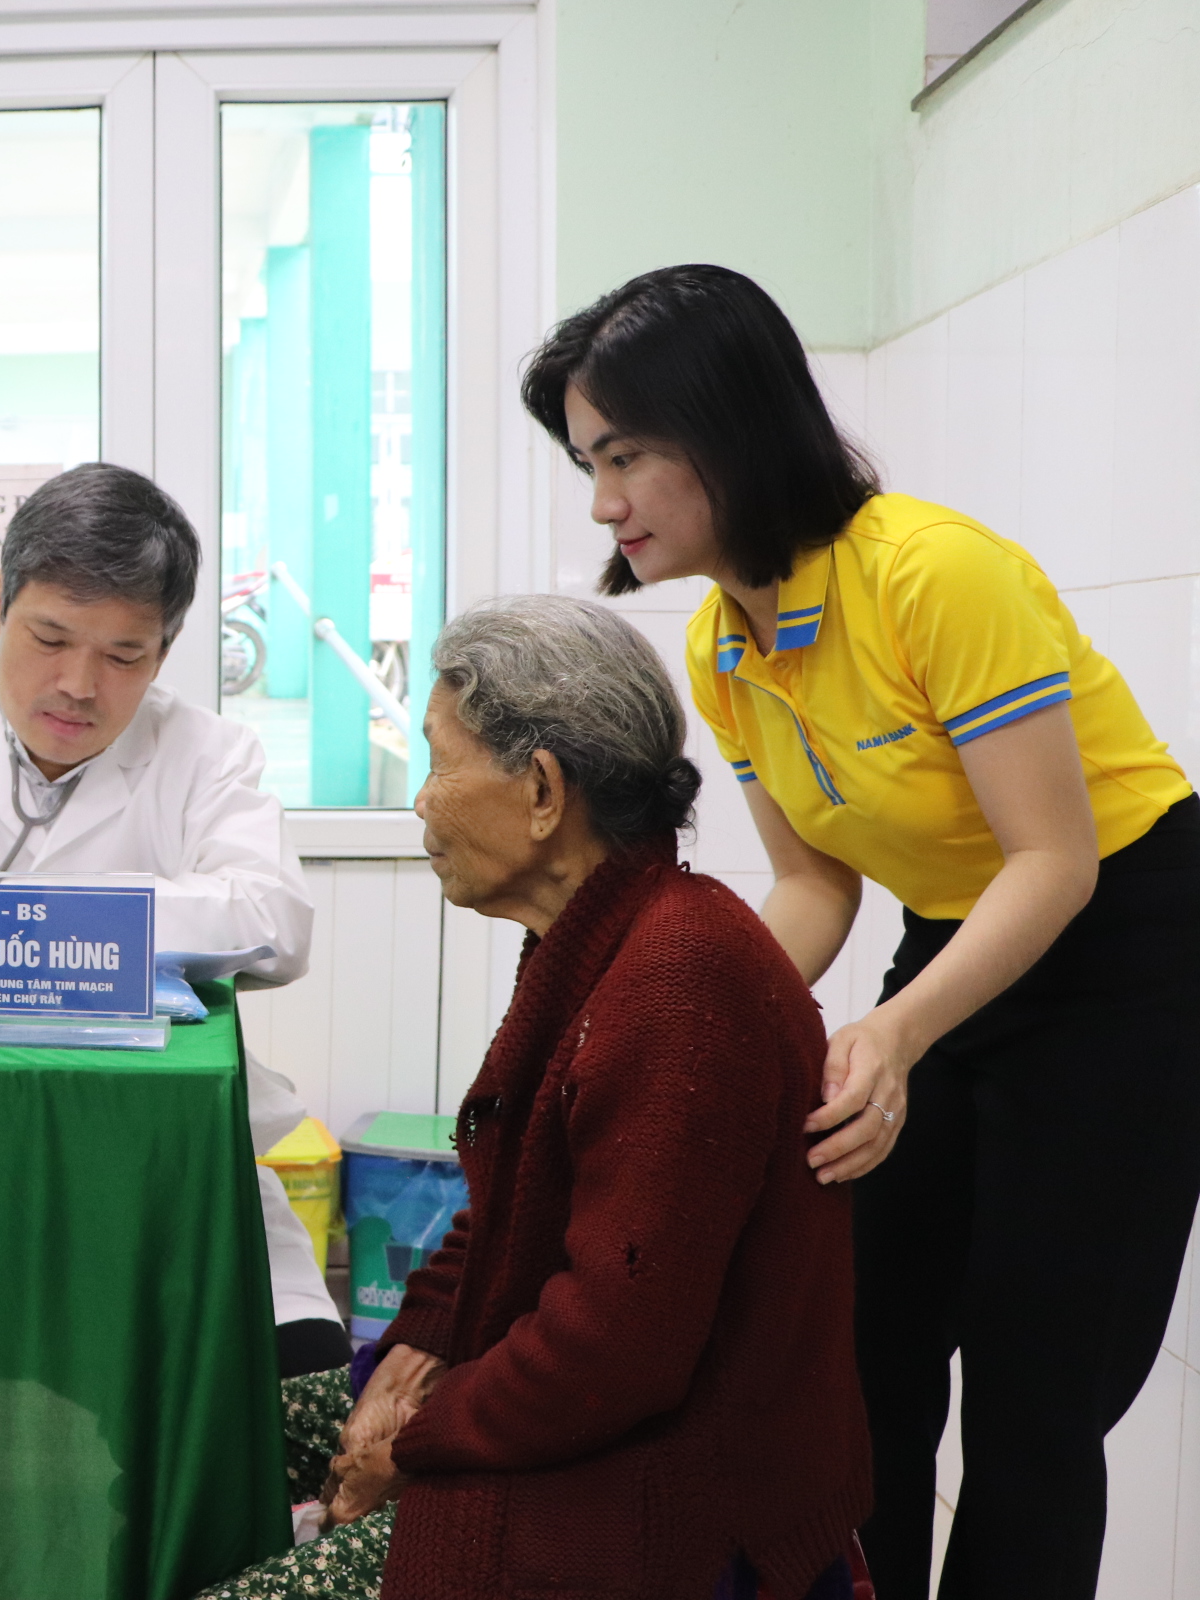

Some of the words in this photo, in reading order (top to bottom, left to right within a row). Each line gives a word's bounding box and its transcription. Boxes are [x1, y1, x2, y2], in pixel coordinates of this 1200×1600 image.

[17, 903, 47, 921] BS
[49, 935, 120, 970] HÙNG
[27, 978, 52, 990] TÂM
[55, 981, 76, 991] TIM
[79, 981, 114, 994] MẠCH
[13, 994, 38, 1006] CHỢ
